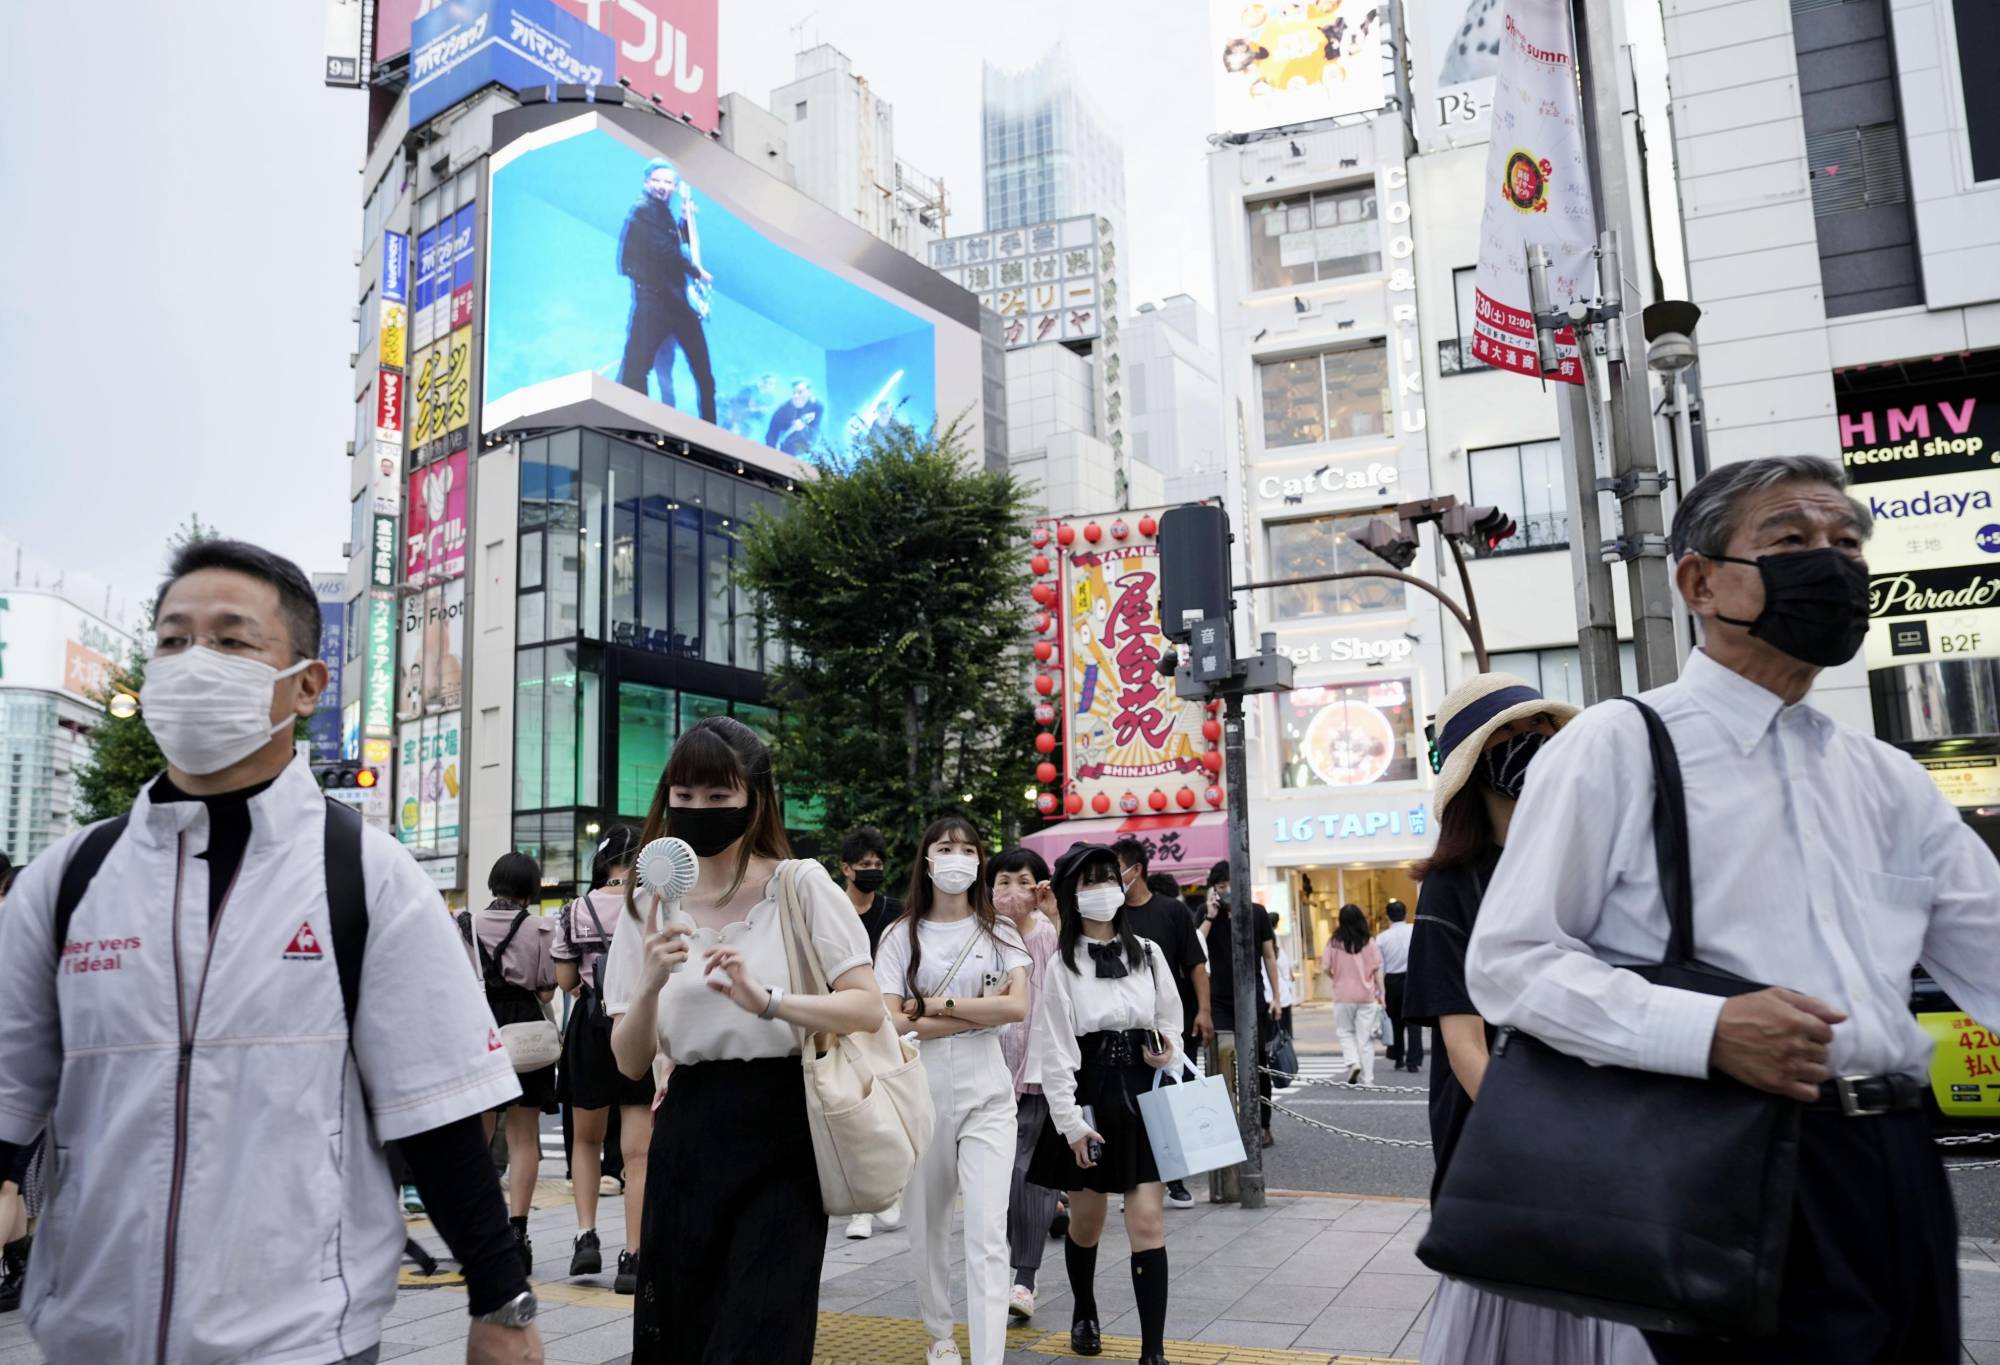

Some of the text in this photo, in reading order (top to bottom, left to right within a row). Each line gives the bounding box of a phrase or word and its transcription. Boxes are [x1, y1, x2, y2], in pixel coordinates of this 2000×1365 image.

[416, 343, 467, 401] ダーツ
[415, 378, 468, 441] グッズ
[1839, 399, 1976, 448] HMV
[1843, 435, 1983, 466] record shop
[1259, 463, 1399, 499] Cat Cafe
[374, 518, 393, 585] 宝石広場
[408, 517, 466, 567] アイフル
[1097, 545, 1160, 563] YATAIE
[1869, 573, 1997, 617] Parade
[407, 601, 465, 632] Dr Foot
[1099, 571, 1177, 749] 屋台苑
[1331, 637, 1412, 662] Shop
[1941, 633, 1981, 653] B2F
[403, 728, 457, 766] 宝石広場
[1103, 760, 1176, 777] SHINJUKU
[1274, 810, 1401, 842] 16 TAPI
[98, 936, 141, 951] vers
